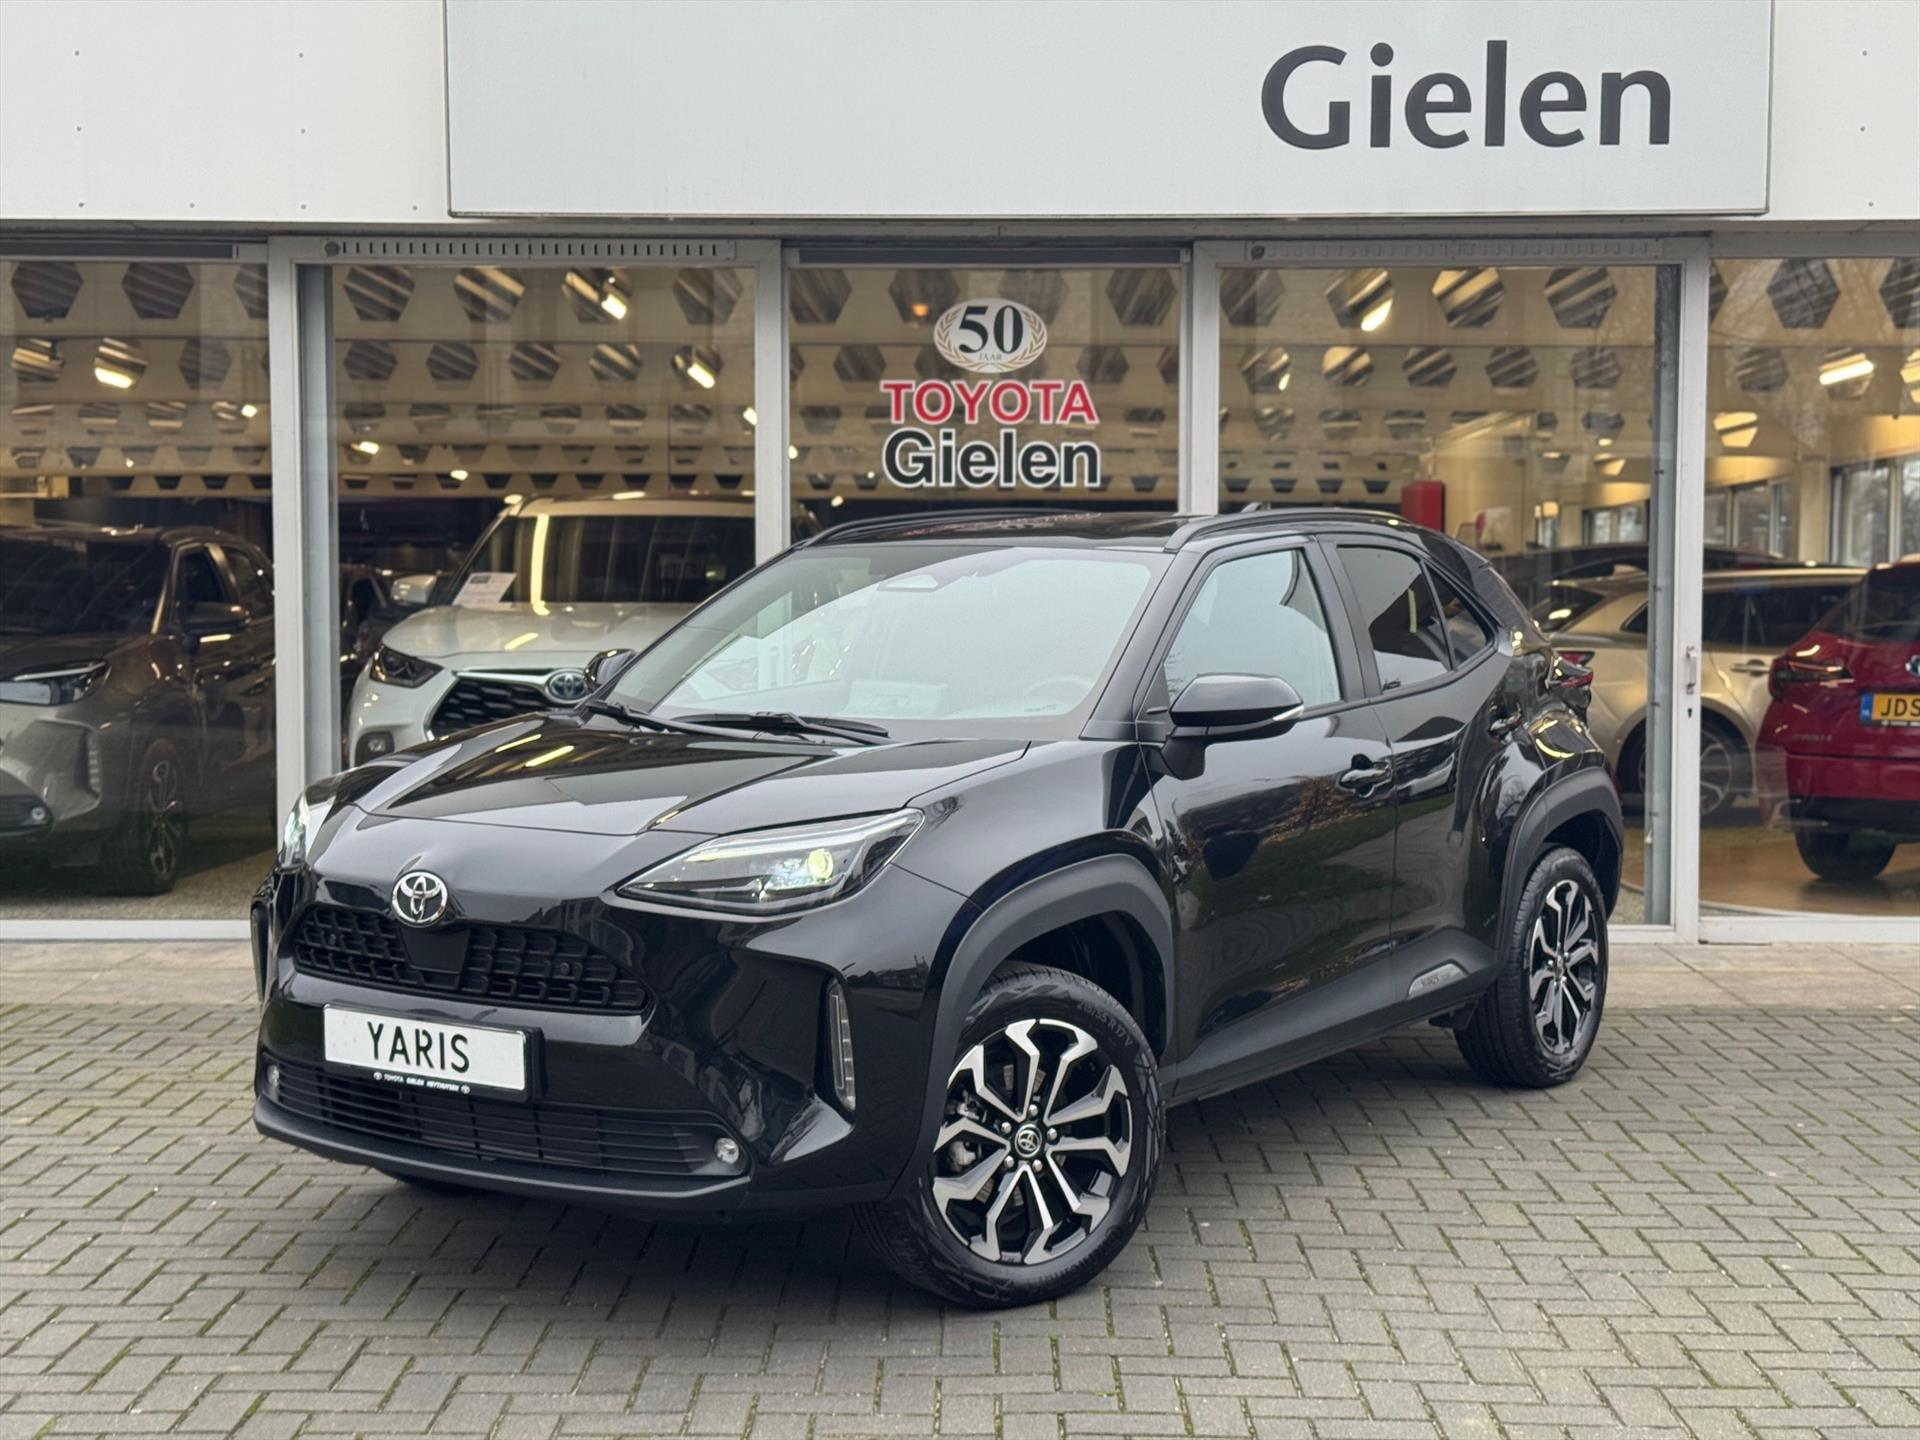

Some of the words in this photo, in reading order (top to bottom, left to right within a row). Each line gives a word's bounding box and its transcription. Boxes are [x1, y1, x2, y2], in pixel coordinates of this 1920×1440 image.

[1260, 40, 1672, 151] Gielen
[958, 305, 1024, 354] 50
[880, 379, 1100, 425] TOYOTA
[882, 427, 1101, 488] Gielen
[367, 1021, 470, 1073] YARIS
